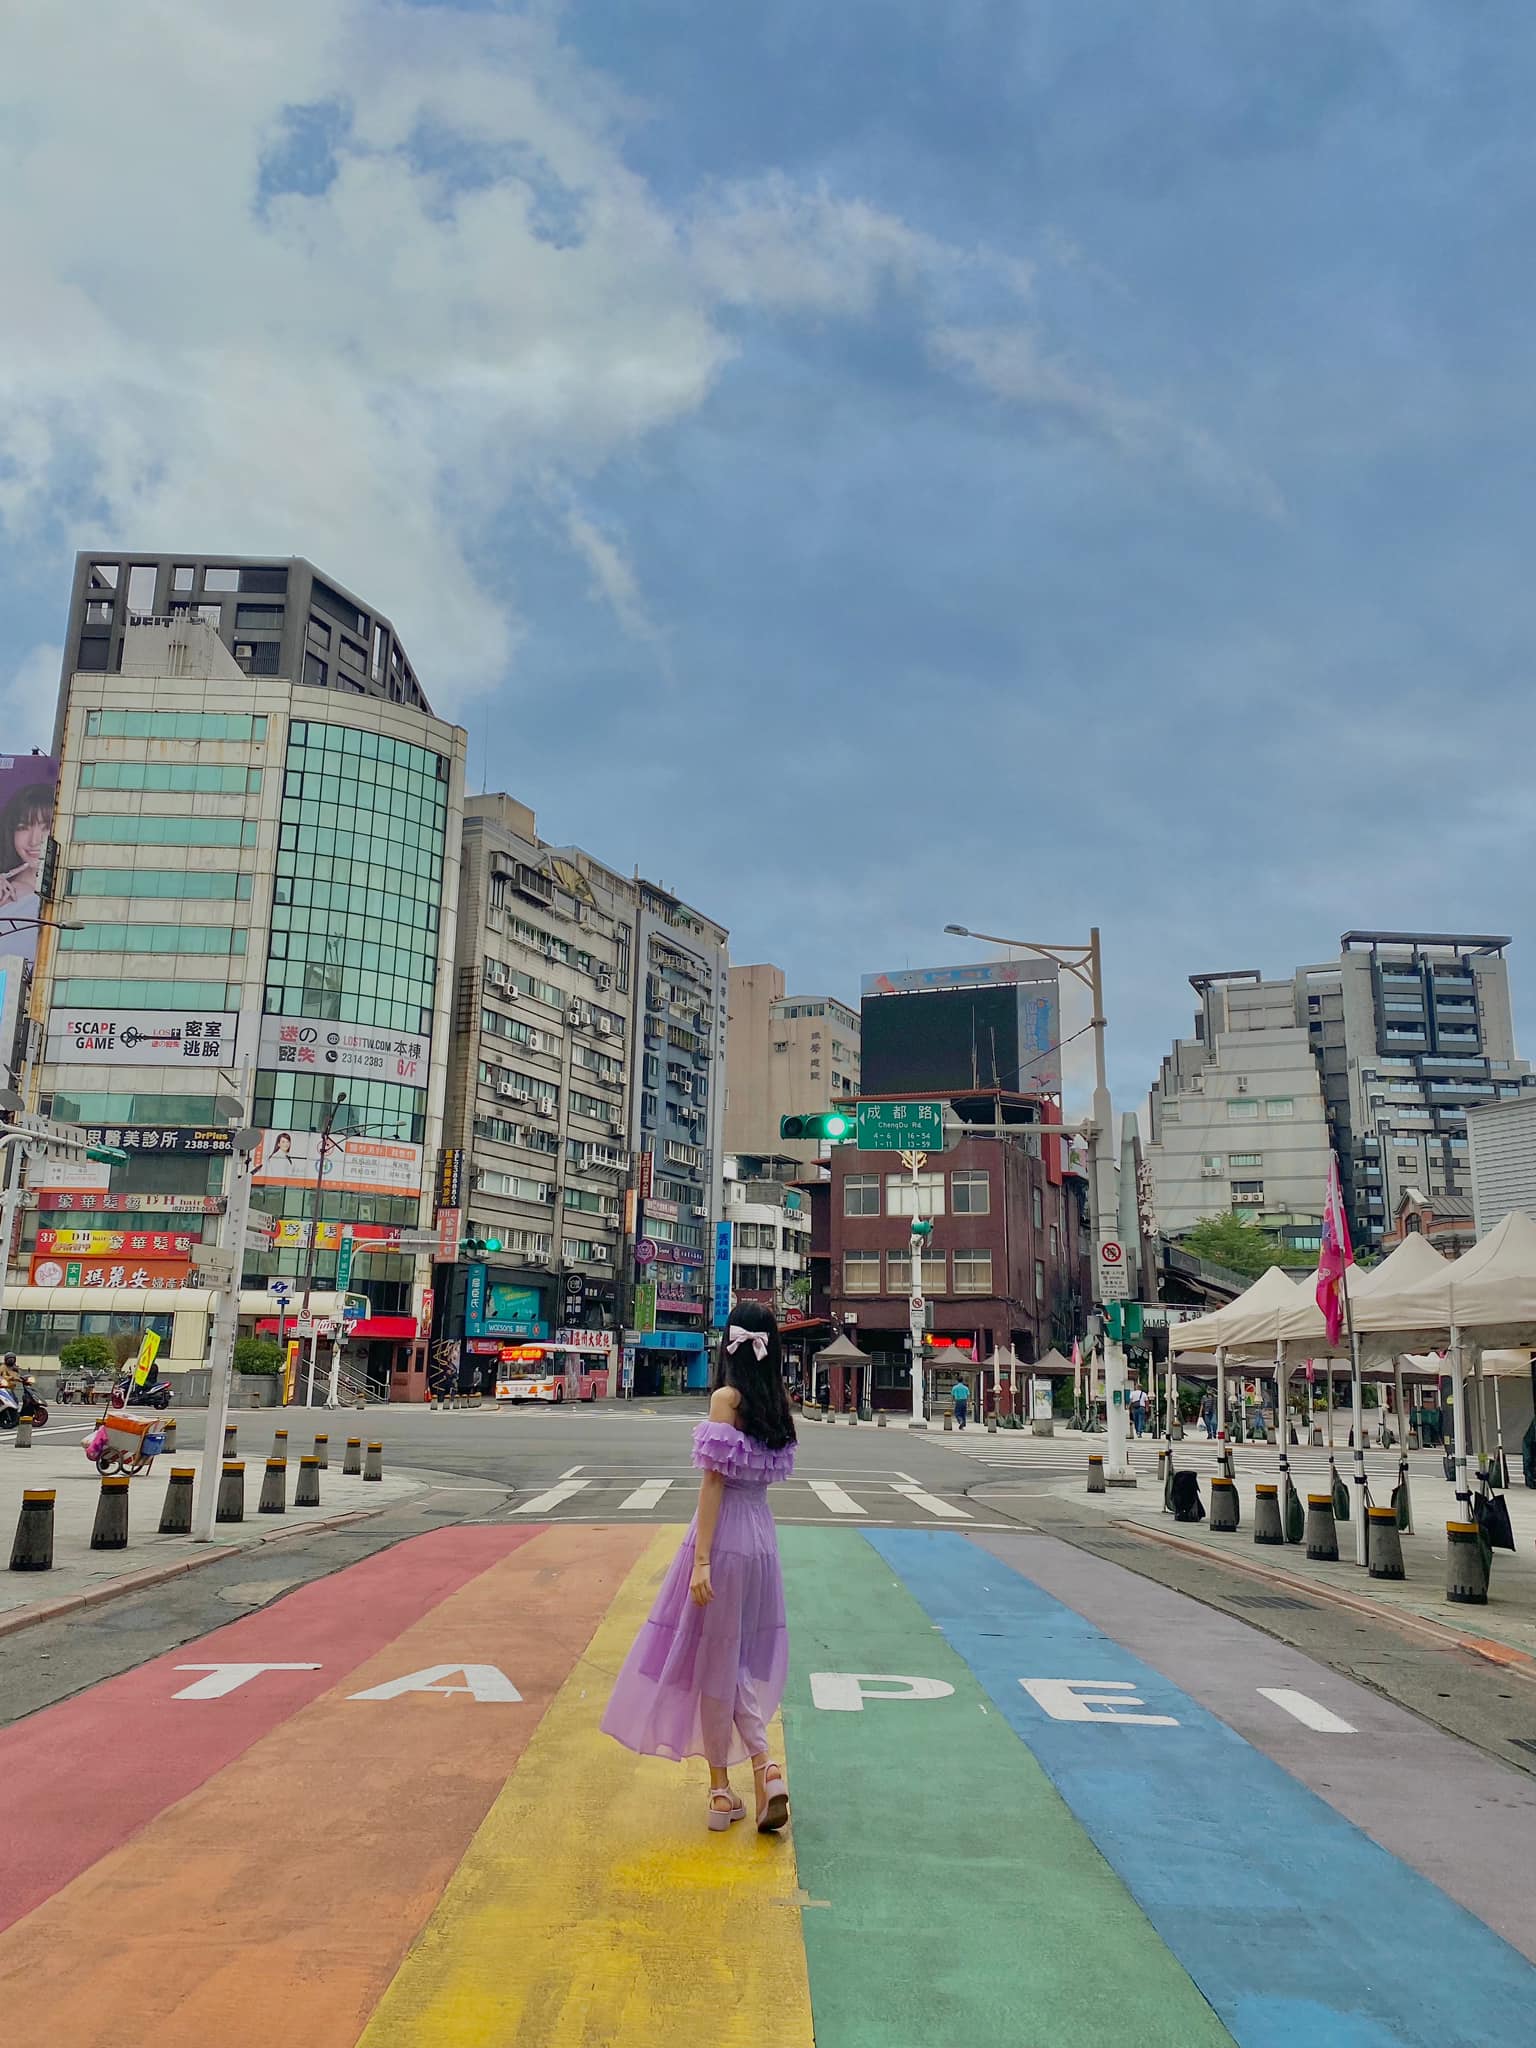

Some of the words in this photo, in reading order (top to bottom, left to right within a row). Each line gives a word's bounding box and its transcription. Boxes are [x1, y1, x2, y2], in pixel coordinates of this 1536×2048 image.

[67, 1022, 117, 1036] ESCAPE
[185, 1021, 222, 1038] 密室
[75, 1037, 115, 1052] GAME
[183, 1040, 220, 1059] 逃脫
[343, 1035, 391, 1051] LOSTTW.COM
[393, 1040, 422, 1060] 本棟
[867, 1105, 932, 1120] 成都路
[85, 1129, 179, 1152] 思醫美診所
[194, 1131, 229, 1143] DrPlus
[40, 1232, 57, 1243] 3F
